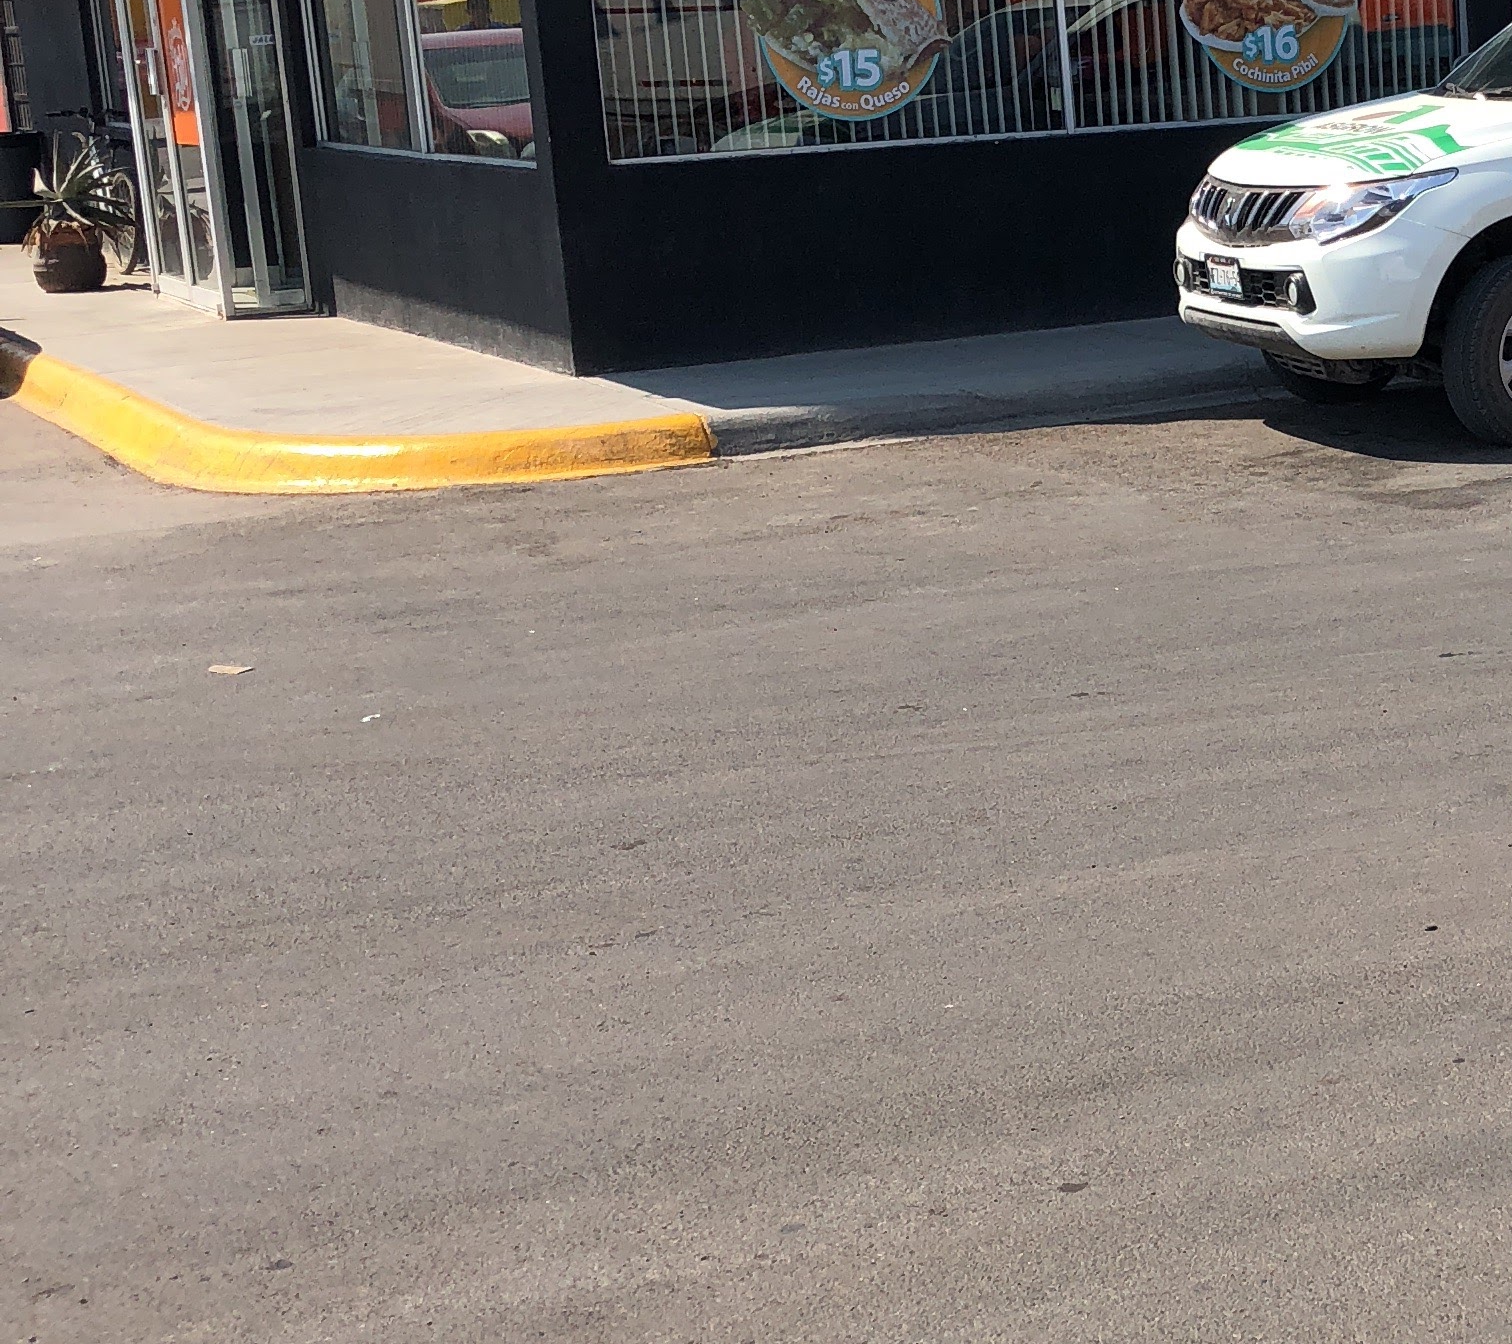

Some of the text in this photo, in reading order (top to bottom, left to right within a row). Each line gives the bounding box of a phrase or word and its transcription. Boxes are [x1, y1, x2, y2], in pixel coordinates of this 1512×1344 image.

[1245, 24, 1299, 61] $16
[818, 48, 882, 88] $15
[1232, 53, 1319, 83] Cochinita Pibil
[797, 76, 910, 110] Rajas con Queso
